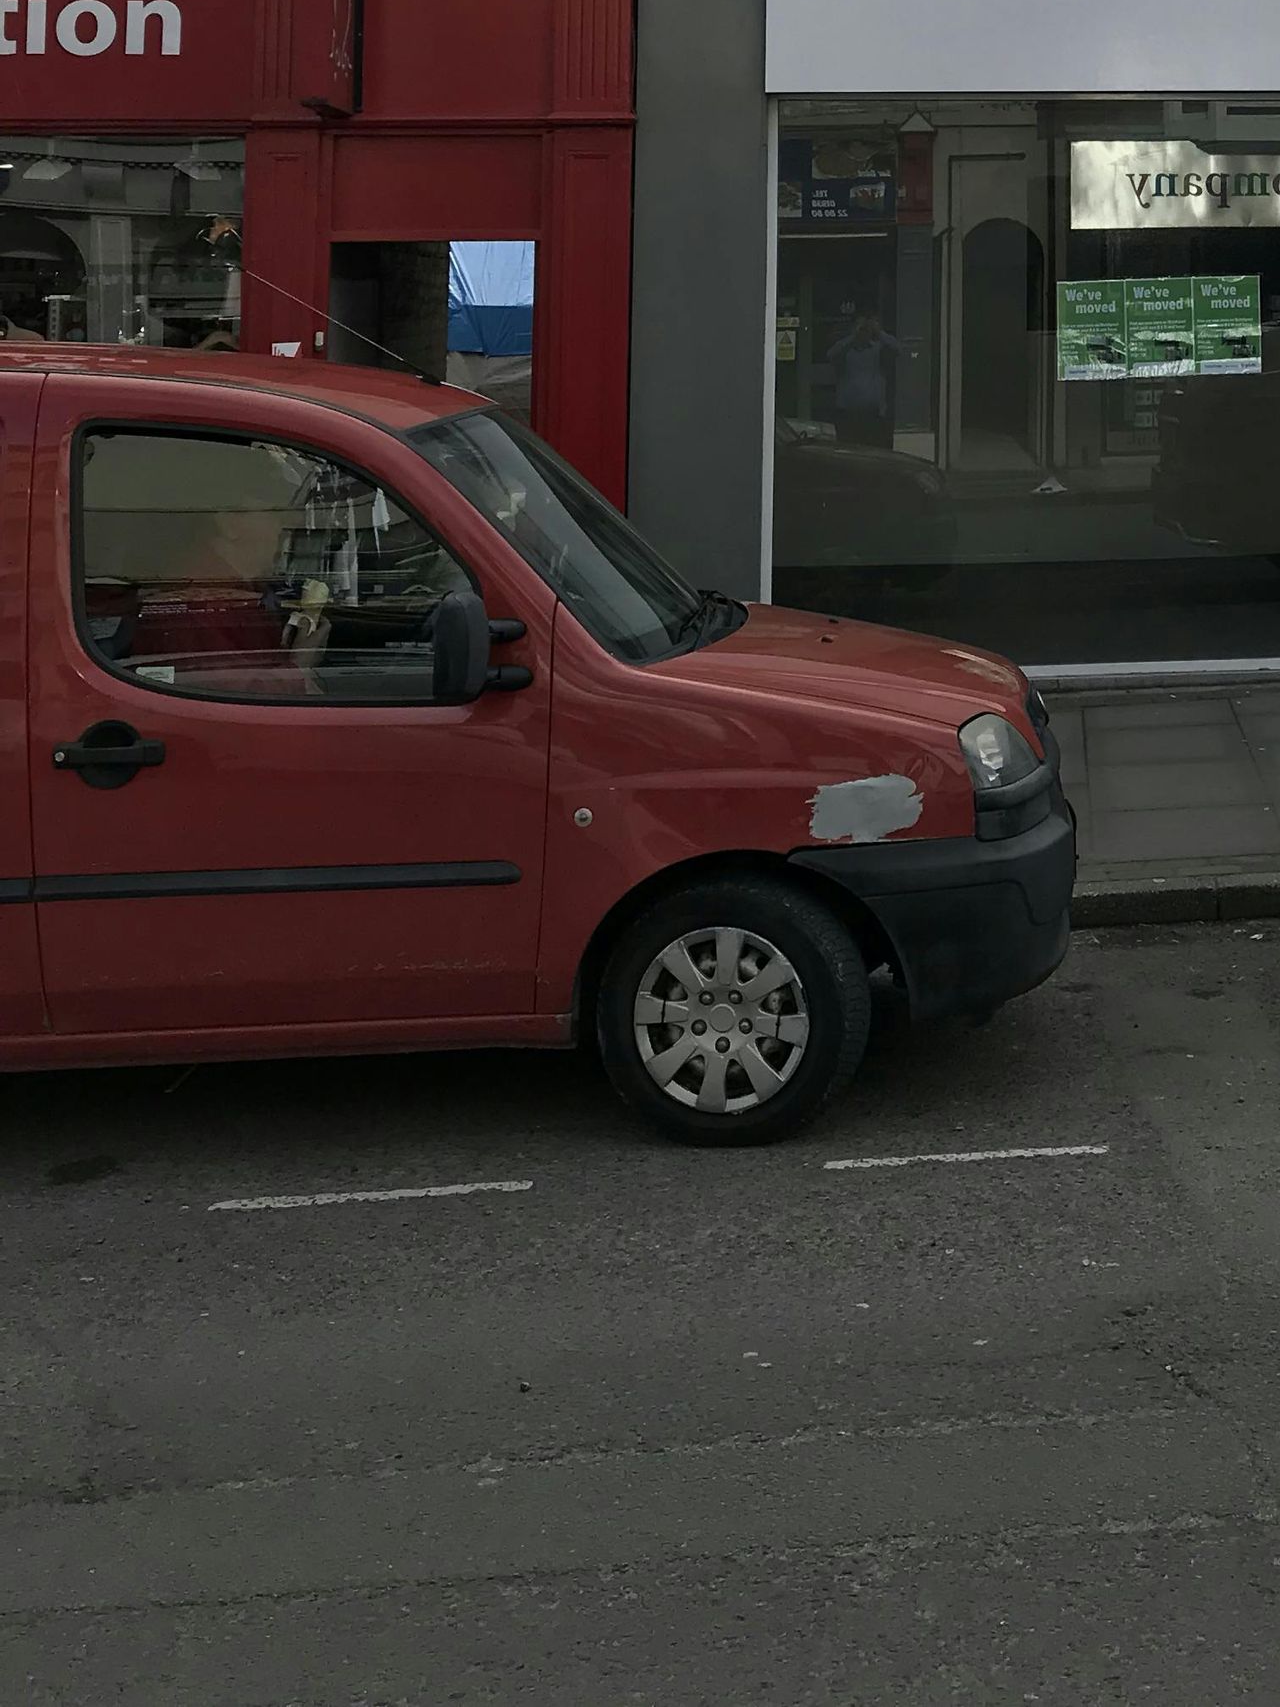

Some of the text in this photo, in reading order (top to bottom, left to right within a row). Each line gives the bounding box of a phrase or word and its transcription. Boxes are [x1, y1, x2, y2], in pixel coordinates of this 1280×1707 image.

[1065, 288, 1102, 302] We've
[1133, 286, 1170, 299] We've
[1200, 284, 1237, 297] We've
[1075, 301, 1116, 314] moved
[1143, 298, 1184, 311] moved
[1211, 296, 1250, 309] moved
